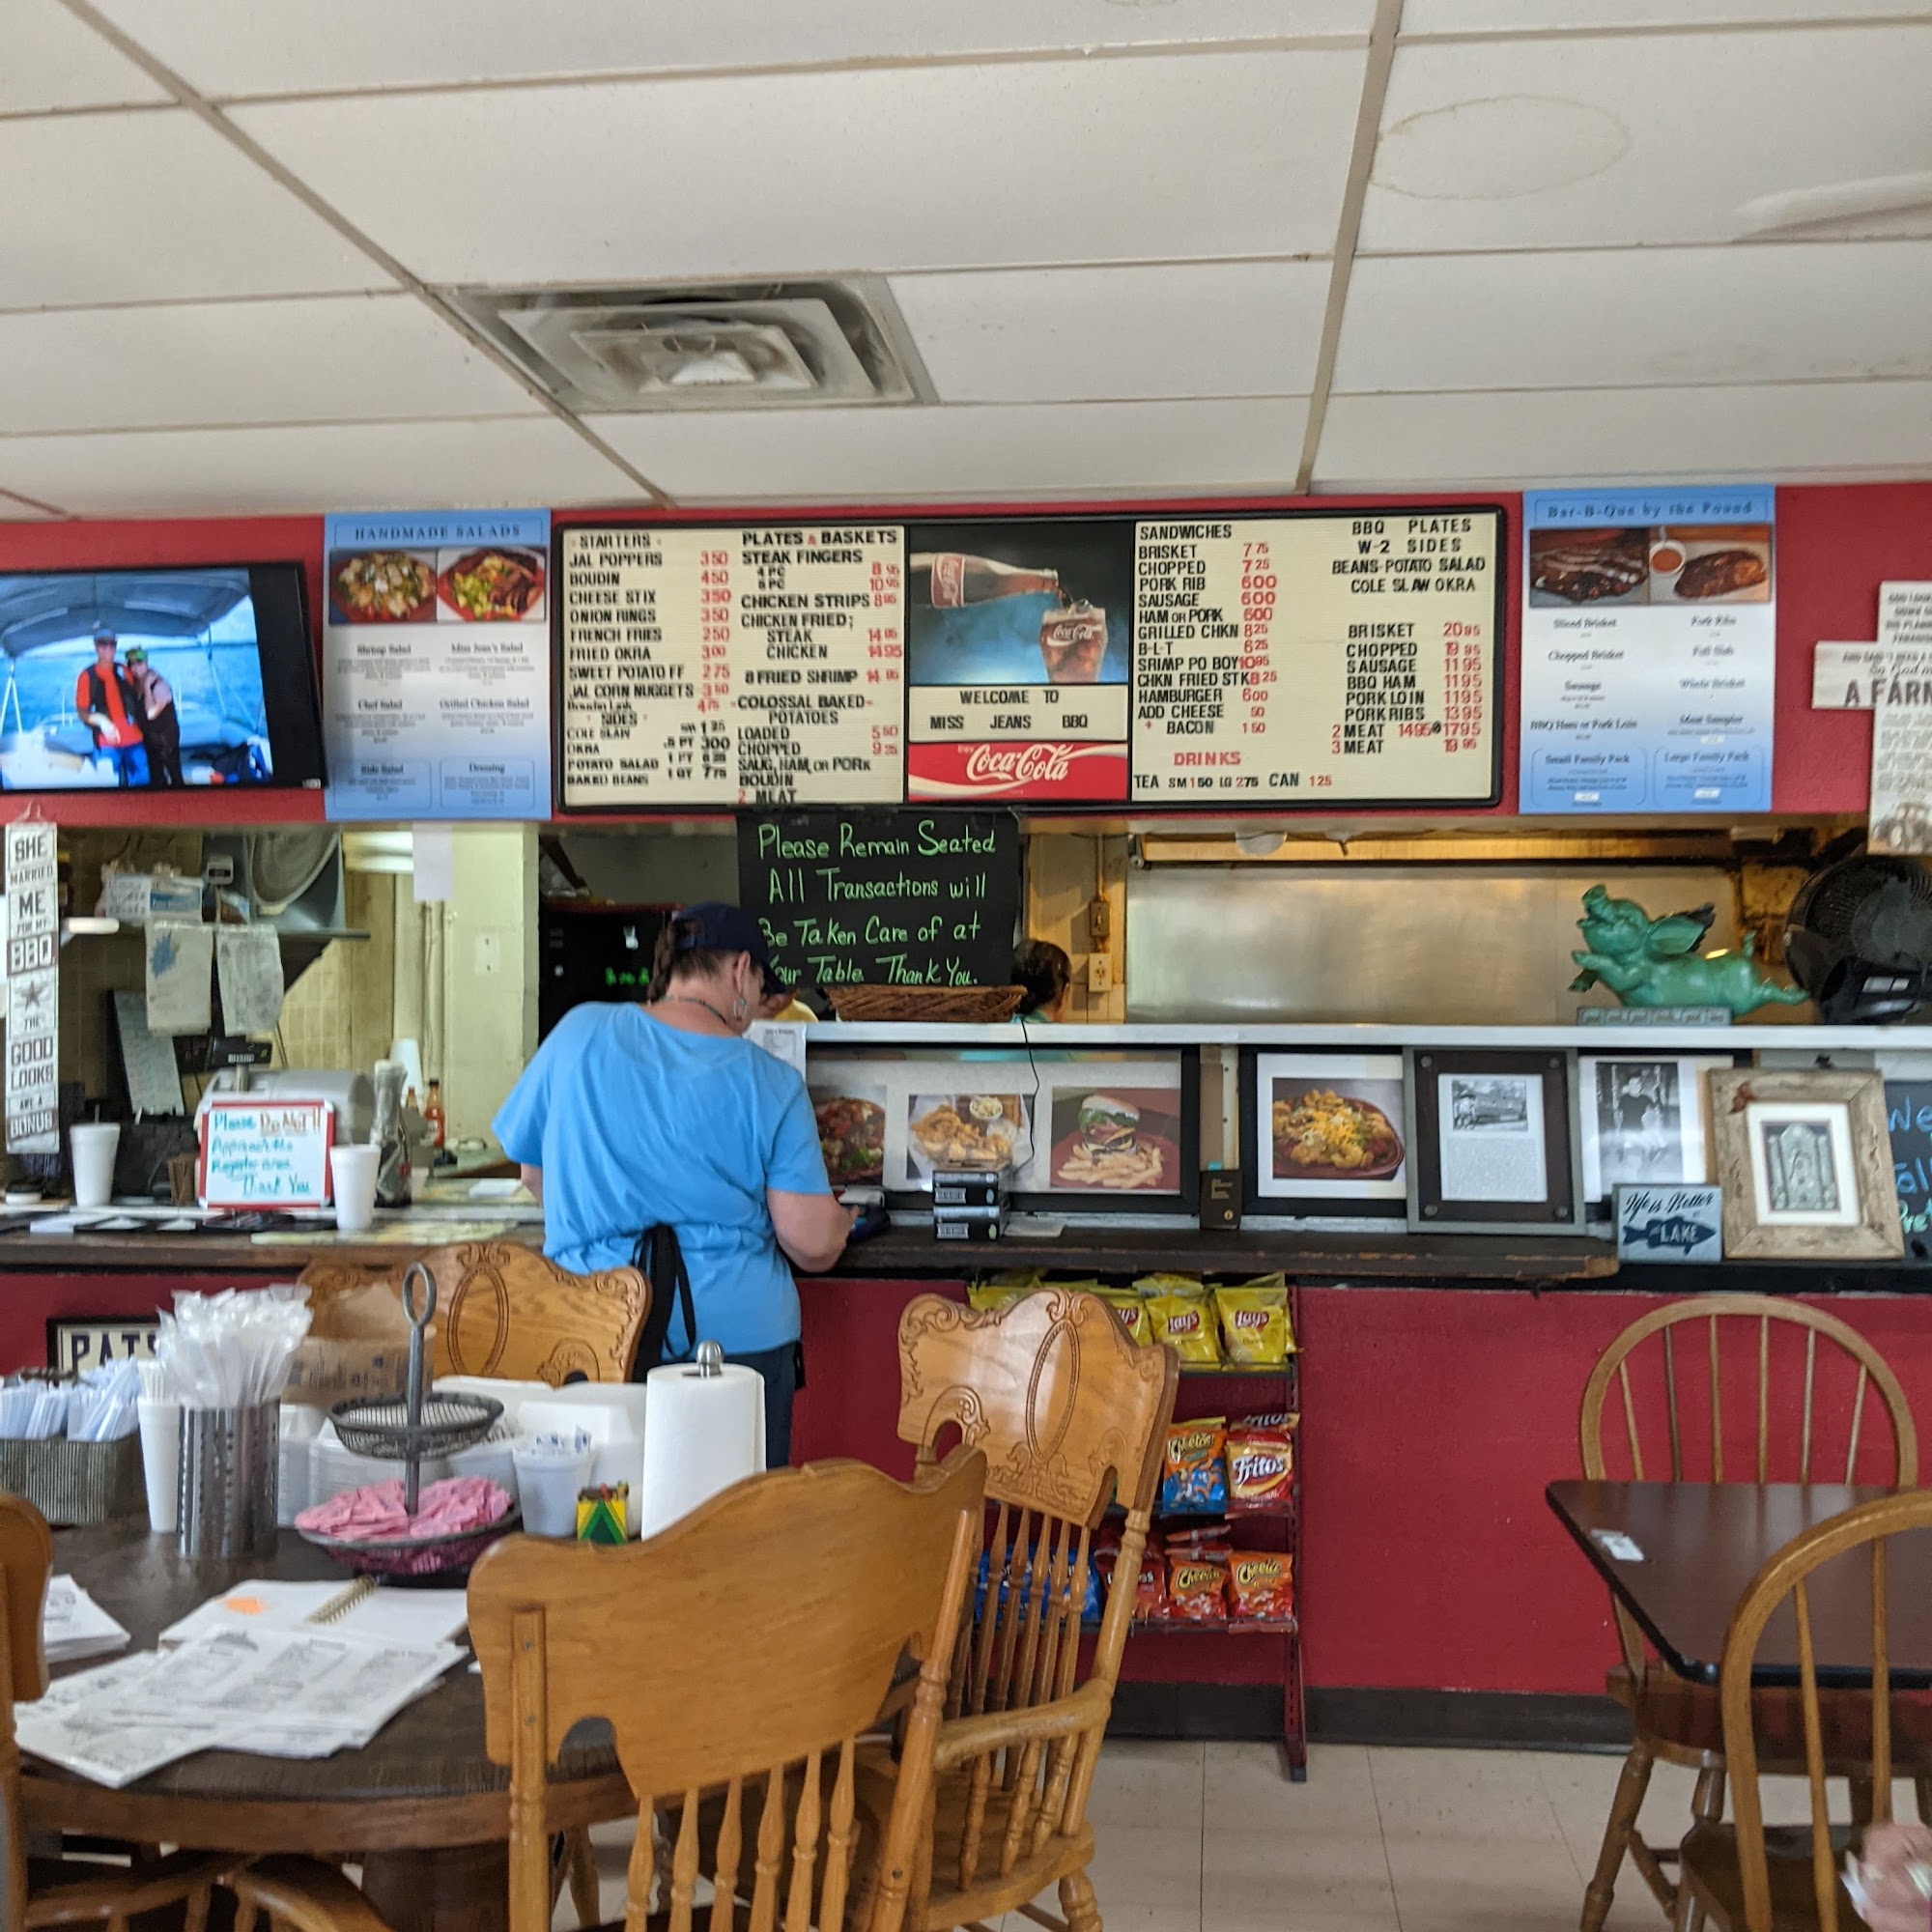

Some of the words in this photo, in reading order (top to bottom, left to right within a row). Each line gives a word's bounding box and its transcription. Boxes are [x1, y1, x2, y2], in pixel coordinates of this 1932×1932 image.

[355, 526, 448, 540] HANDMADE
[457, 525, 521, 538] SALADS
[1140, 526, 1232, 540] SANDWICHES
[1352, 521, 1384, 535] BBQ
[1408, 519, 1470, 532] PLATES
[743, 532, 803, 545] PLATES
[821, 531, 896, 544] BASKETS
[1139, 545, 1197, 559] BRISKET
[1407, 538, 1462, 553] SIDES
[743, 551, 791, 564] STEAK
[797, 550, 863, 563] FINGERS
[1139, 561, 1206, 575] CHOPPED
[1439, 557, 1485, 572] SALAD
[570, 572, 620, 585] BOUDIN
[1140, 578, 1177, 591] PORK
[1183, 578, 1206, 590] RIB
[1351, 580, 1386, 593] COLE
[1393, 579, 1431, 592] SLAW
[1435, 578, 1476, 592] OKRA
[570, 591, 619, 605] CHEESE
[626, 590, 656, 604] STIX
[742, 595, 808, 608] CHICKEN
[814, 594, 869, 608] STRIPS
[1139, 594, 1200, 607] SAUSAGE
[570, 610, 612, 623] ONION
[742, 613, 797, 627] CHICKEN
[1139, 611, 1169, 623] HAM
[1189, 609, 1222, 622] PORK
[767, 630, 812, 642] STEAK
[1139, 626, 1195, 639] GRILLED
[1202, 625, 1238, 638] CHKN
[1349, 623, 1414, 639] BRISKET
[615, 647, 651, 661] OKRA
[766, 645, 827, 659] CHICKEN
[1347, 642, 1417, 658] CHOPPED
[1139, 657, 1183, 671] SRIMP
[1189, 657, 1207, 670] PO
[1212, 657, 1239, 669] BOY
[1347, 659, 1416, 673] SAUSAGE
[618, 666, 665, 679] POTATO
[758, 670, 801, 684] FRIED
[808, 669, 858, 683] SHRIMP
[1138, 673, 1173, 687] CHKN
[1179, 673, 1218, 686] FRIED
[1348, 676, 1377, 689] BBQ
[1383, 675, 1415, 689] HAM
[738, 696, 811, 708] COLOSSAL
[818, 695, 865, 708] BAKED
[960, 691, 1029, 704] WELCOME
[1043, 690, 1059, 703] TO
[1139, 689, 1222, 703] HAMBURGER
[1347, 692, 1386, 705] PORK
[1390, 691, 1424, 705] LOIN
[769, 710, 838, 724] POTATOES
[1138, 706, 1164, 719] ADD
[1172, 704, 1224, 718] CHEESE
[1345, 708, 1386, 722] PORK
[1389, 707, 1425, 721] RIBS
[930, 716, 964, 728] MISS
[990, 715, 1031, 728] JEANS
[1063, 715, 1088, 727] BBQ
[1167, 721, 1214, 734] BACON
[738, 726, 790, 740] LOADED
[1332, 724, 1341, 739] 2
[1345, 724, 1384, 737] MEAT
[738, 742, 800, 755] CHOPPED
[1332, 742, 1341, 754] 3
[1345, 740, 1384, 753] MEAT
[833, 757, 870, 771] PORK
[1174, 752, 1241, 766] DRINKS
[739, 774, 793, 786] BOUDIN
[1134, 775, 1159, 788] TEA
[1169, 778, 1186, 788] SM
[1269, 773, 1299, 787] CAN
[758, 824, 830, 860] Please
[840, 823, 910, 858] Remain
[918, 820, 996, 856] Seated
[769, 867, 805, 904] All
[815, 867, 938, 901] Transactions
[950, 872, 986, 899] will
[19, 890, 46, 917] ME
[793, 918, 856, 947] Taken
[866, 916, 908, 945] Care
[918, 916, 943, 942] of
[953, 910, 980, 942] at
[875, 953, 941, 985] Thank
[12, 1037, 53, 1065] GOOD
[1661, 1223, 1698, 1243] LAKE
[1233, 1456, 1284, 1490] Fritos
